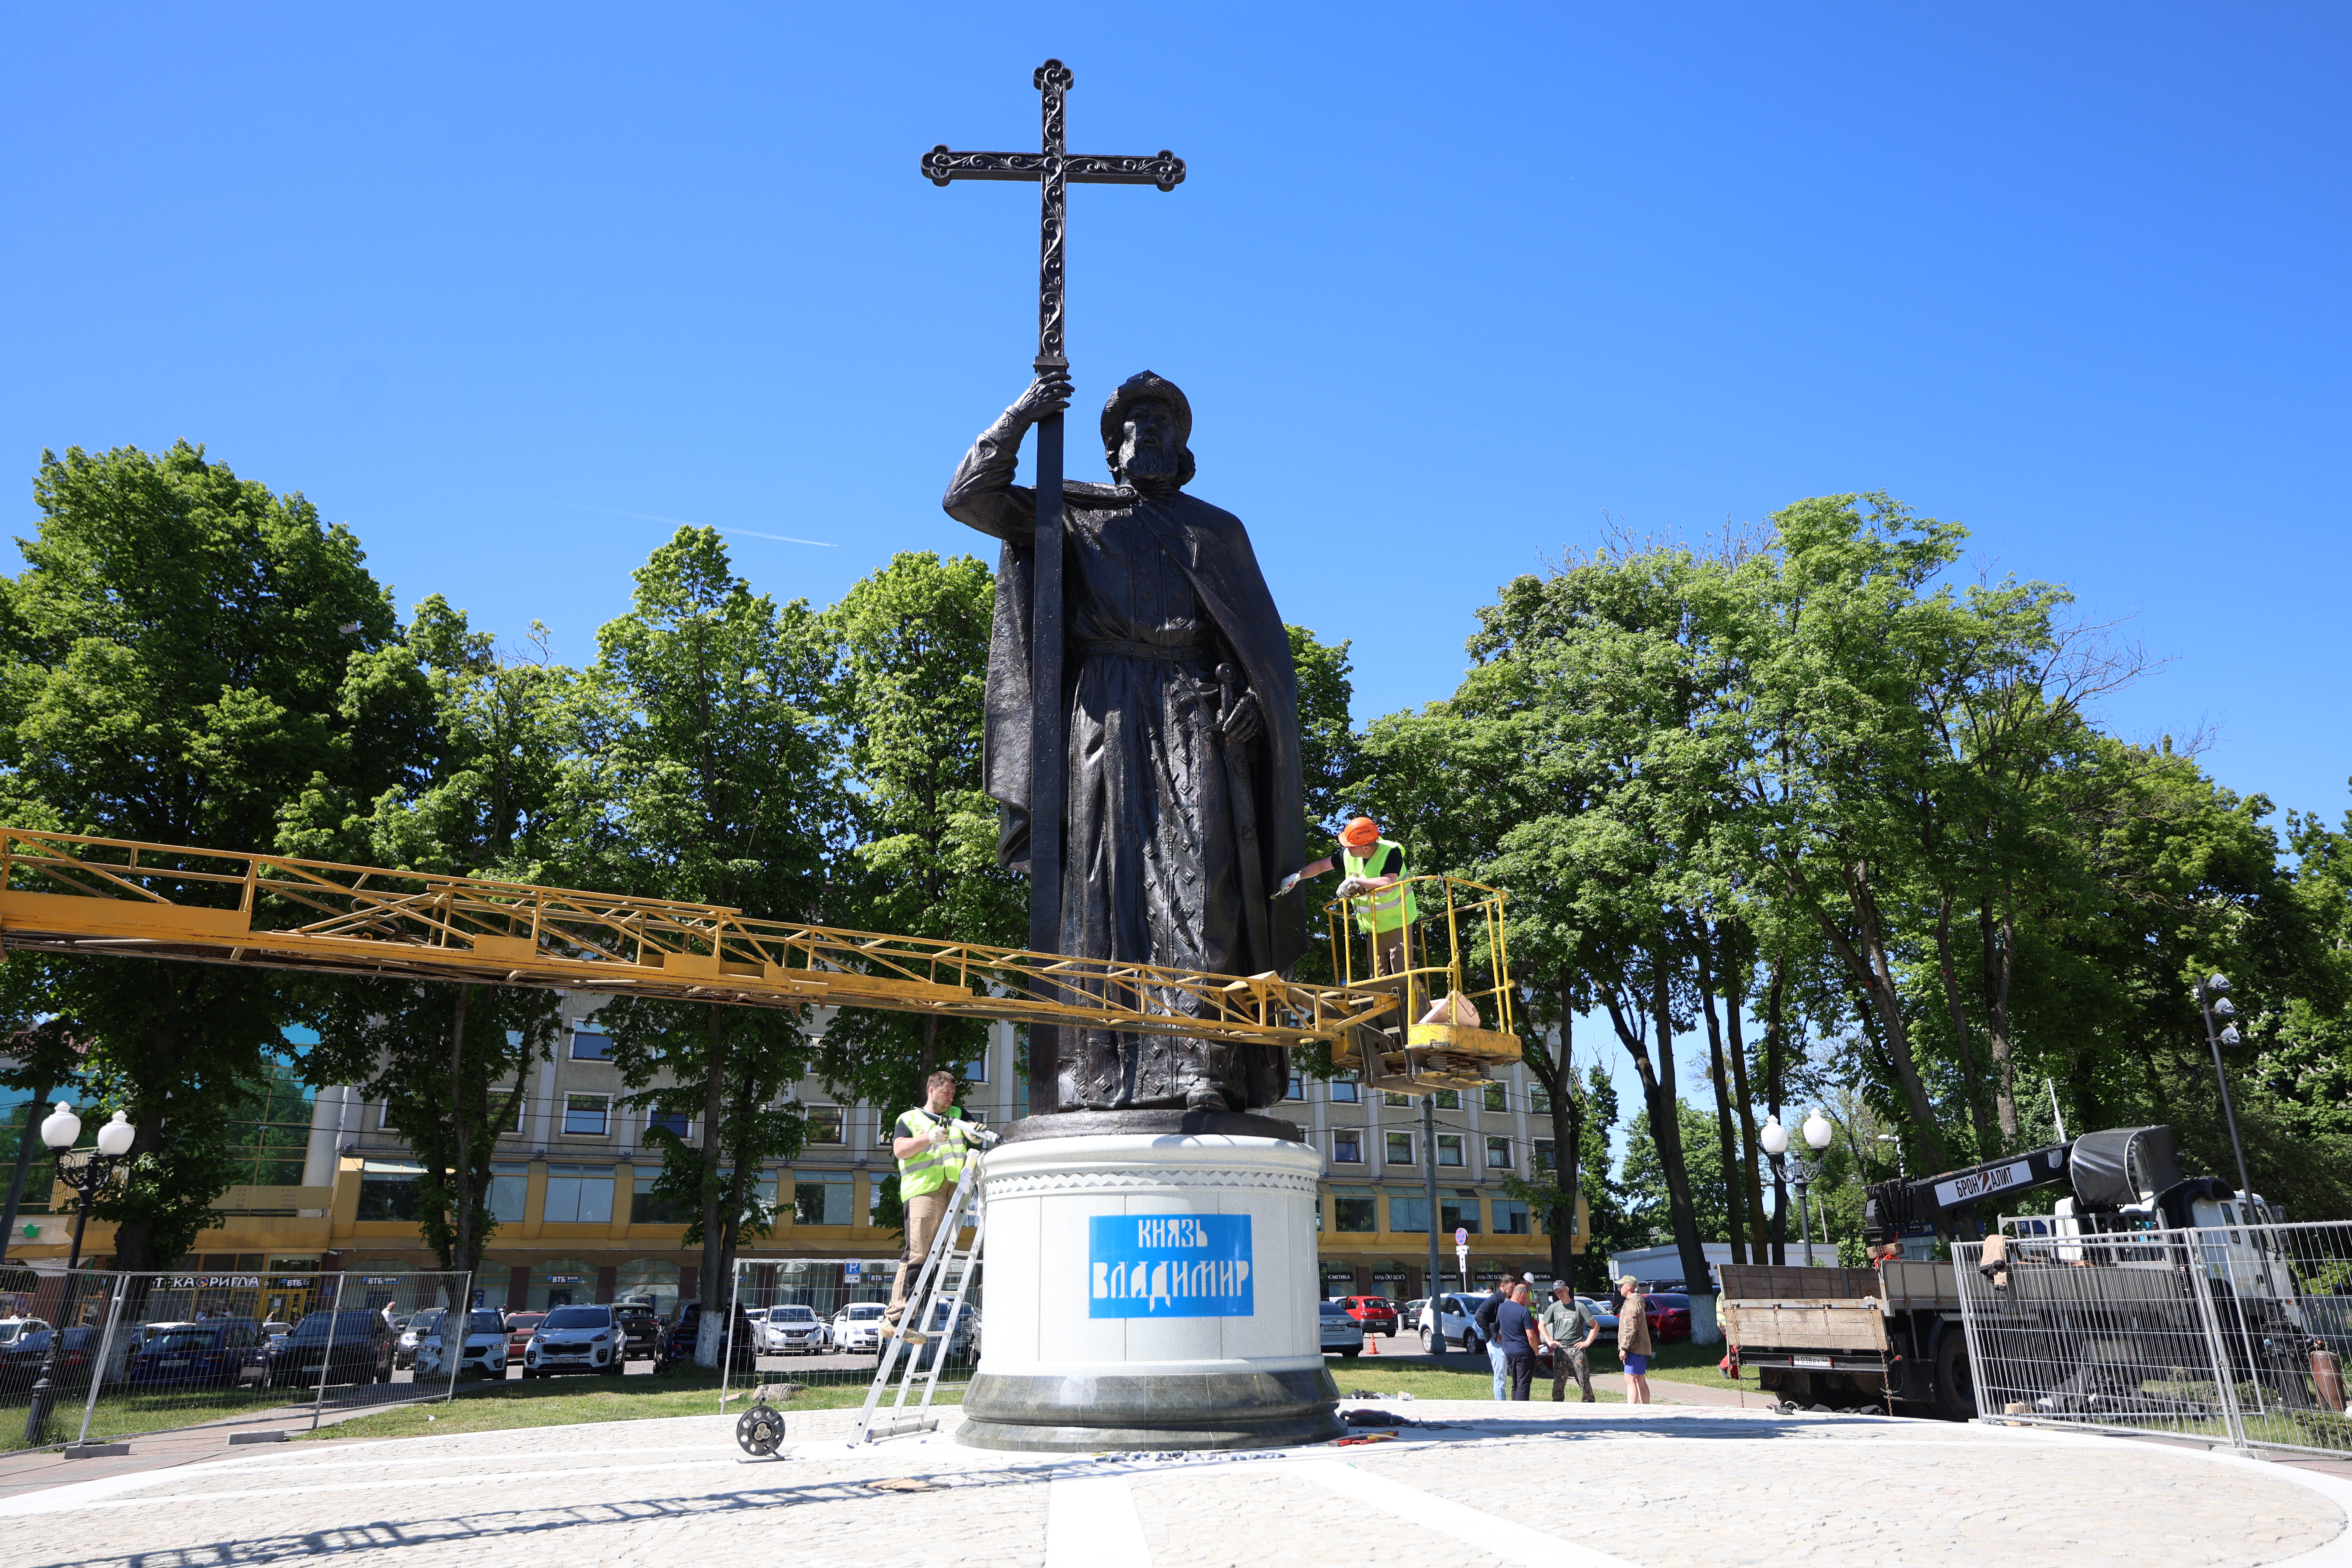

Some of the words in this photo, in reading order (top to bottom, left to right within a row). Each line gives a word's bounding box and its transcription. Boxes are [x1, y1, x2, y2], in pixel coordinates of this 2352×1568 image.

[1138, 1219, 1208, 1248] КНЯЗЬ
[210, 1277, 259, 1287] РИГЛА
[1093, 1260, 1249, 1312] ВЛАДИМИР
